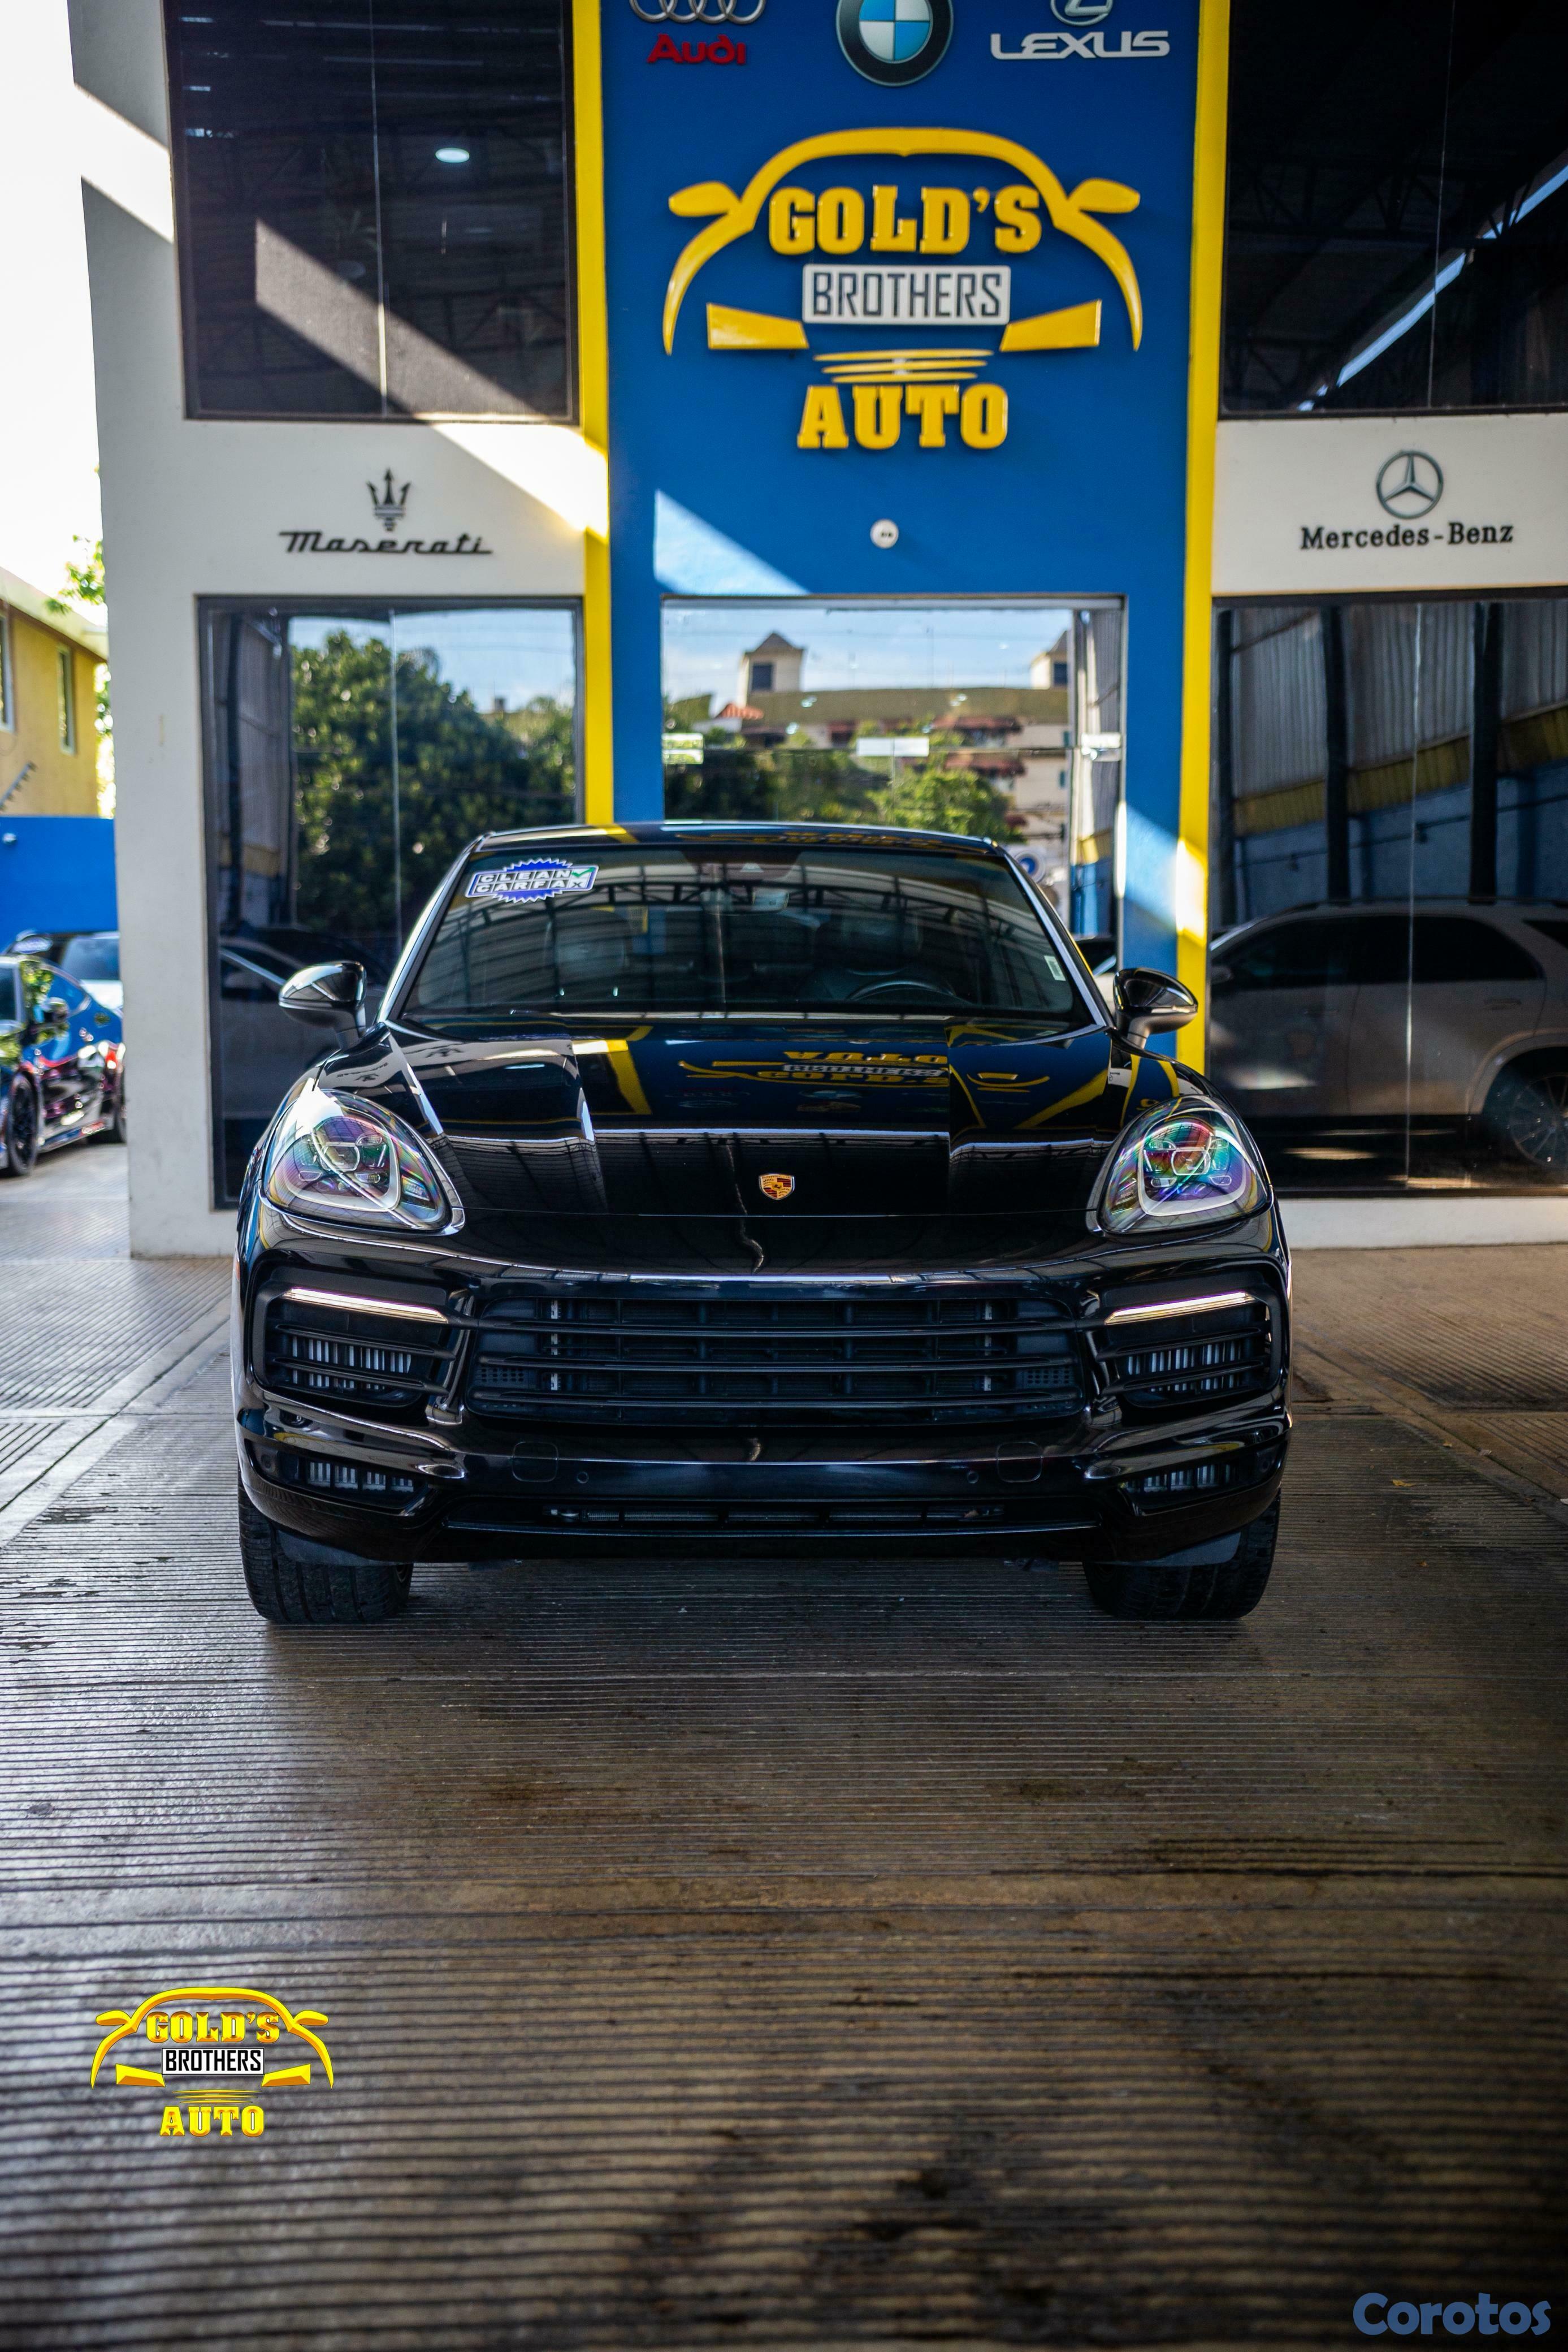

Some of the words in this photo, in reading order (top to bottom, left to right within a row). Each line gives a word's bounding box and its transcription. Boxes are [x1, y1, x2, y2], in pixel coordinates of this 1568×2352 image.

[647, 33, 746, 65] Audi
[990, 31, 1171, 59] LEXUS
[769, 184, 1042, 254] GOLD'S
[812, 272, 1001, 319] BROTHERS
[797, 383, 1008, 449] AUTO
[279, 531, 493, 555] Maserati
[475, 880, 586, 893] CARFAX
[480, 870, 571, 884] CLEAN
